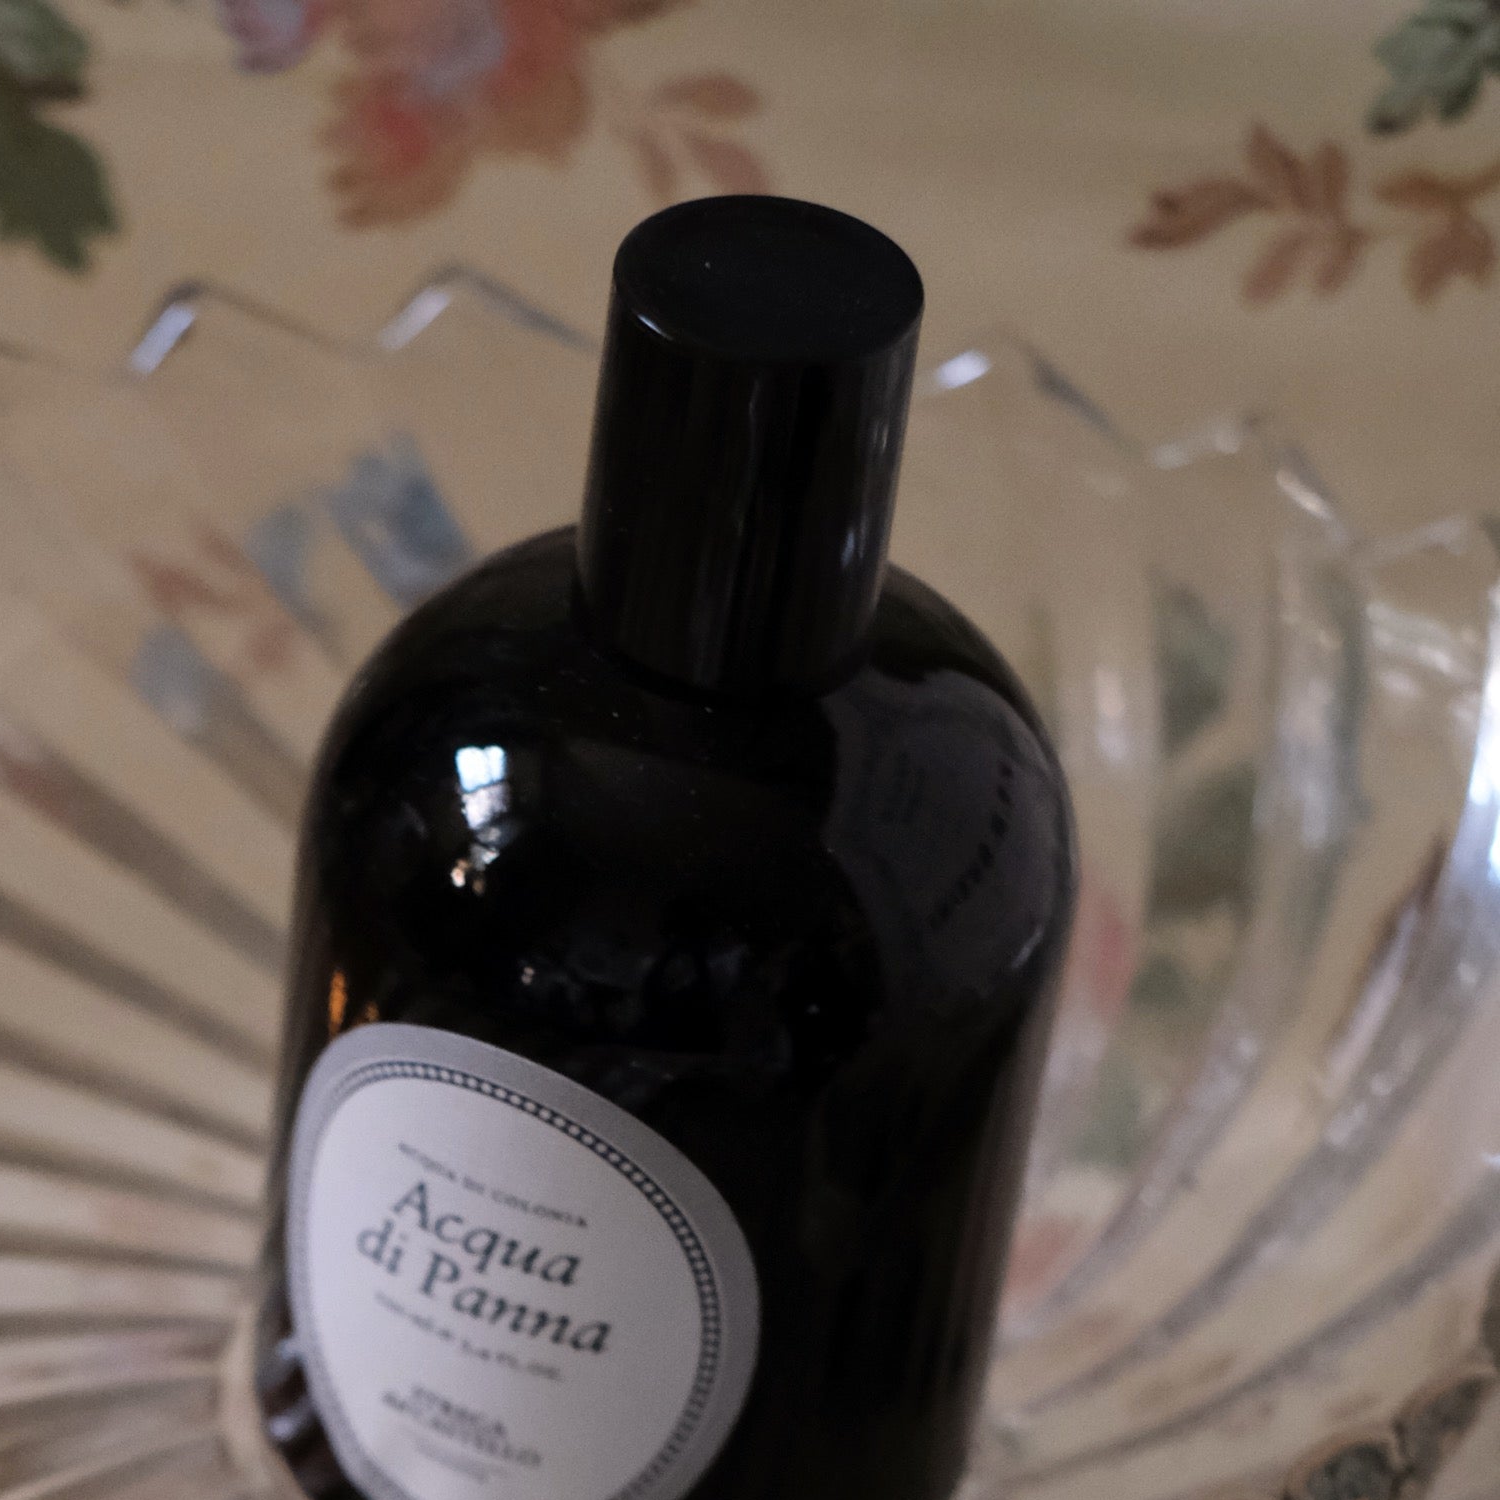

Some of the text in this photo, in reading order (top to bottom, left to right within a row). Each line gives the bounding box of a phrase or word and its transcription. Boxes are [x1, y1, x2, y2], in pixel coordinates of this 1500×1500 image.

[356, 1218, 404, 1276] di
[420, 1251, 613, 1355] Panna
[392, 1180, 582, 1287] Acqua
